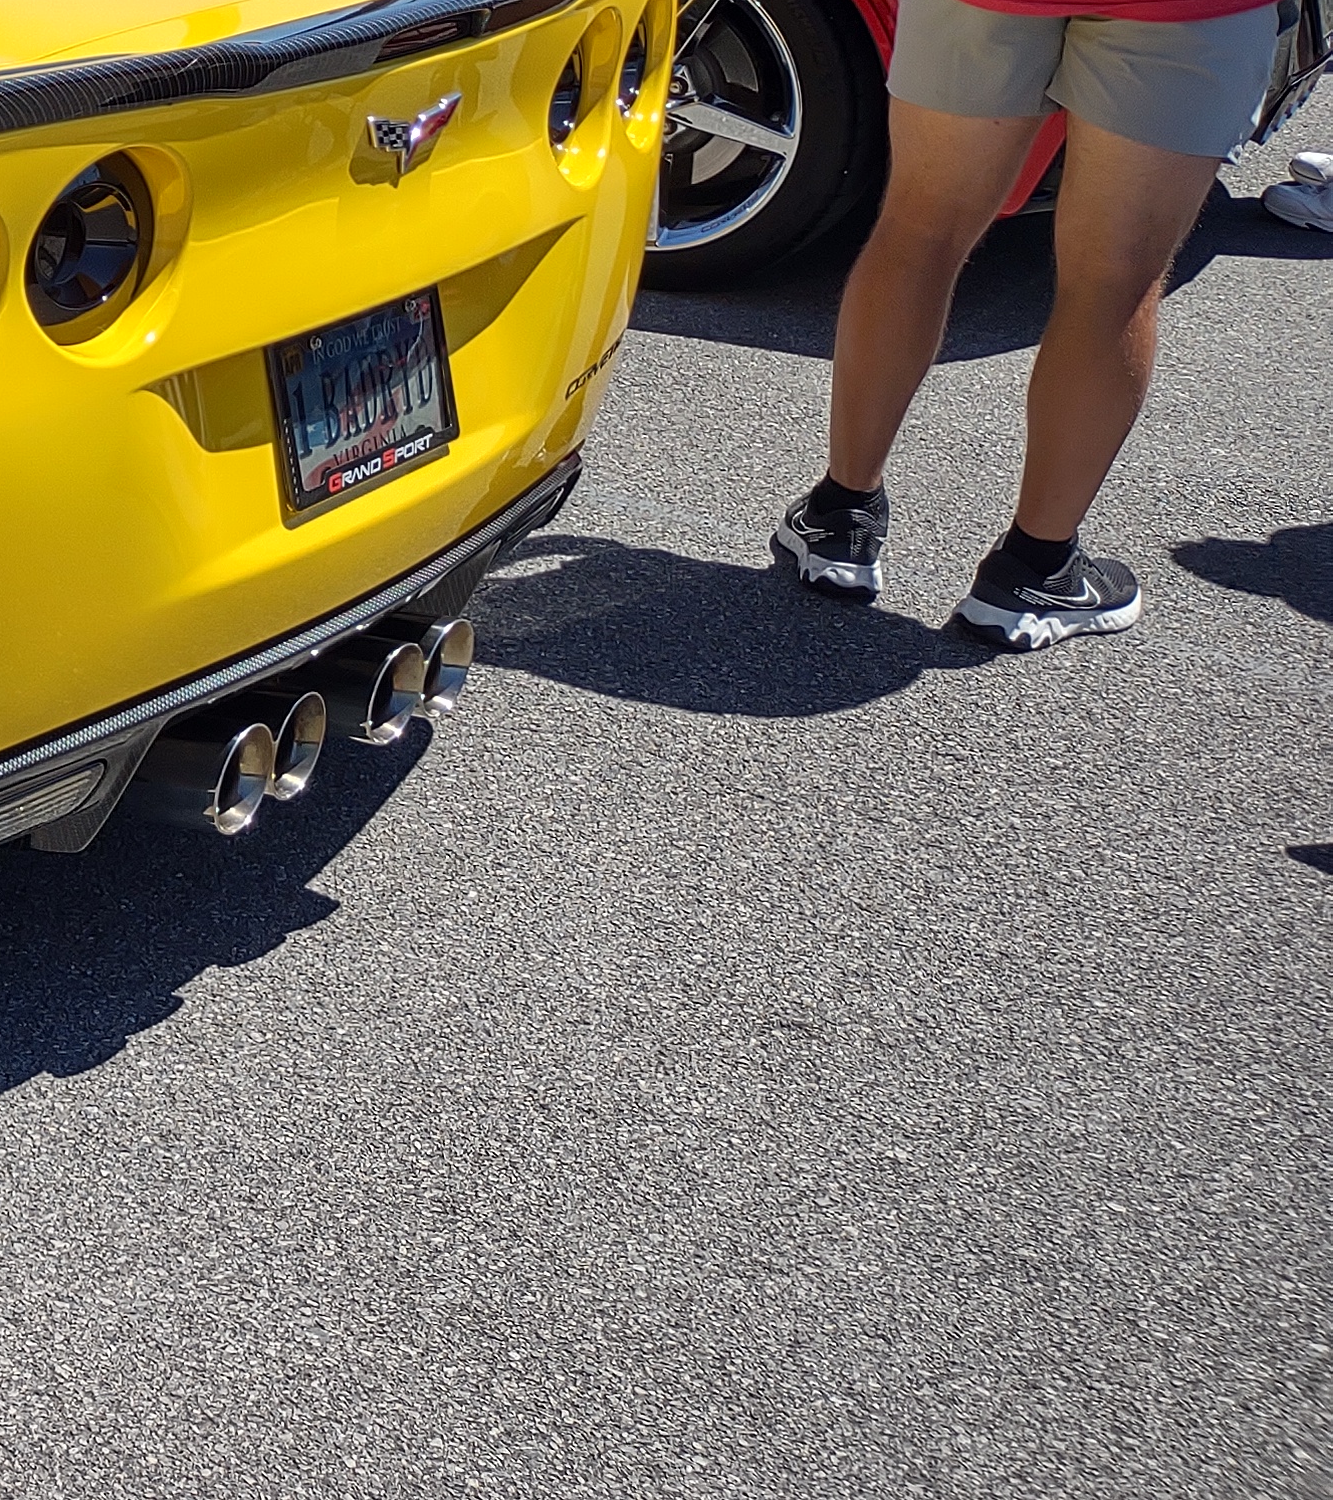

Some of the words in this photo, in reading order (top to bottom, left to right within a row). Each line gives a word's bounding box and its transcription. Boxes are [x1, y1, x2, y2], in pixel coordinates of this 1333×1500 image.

[327, 337, 351, 359] GOD
[352, 330, 370, 347] WE
[370, 317, 401, 343] TRUST
[329, 456, 382, 493] GRAND
[382, 433, 433, 468] SPORT
[333, 424, 408, 466] VIRGINIA
